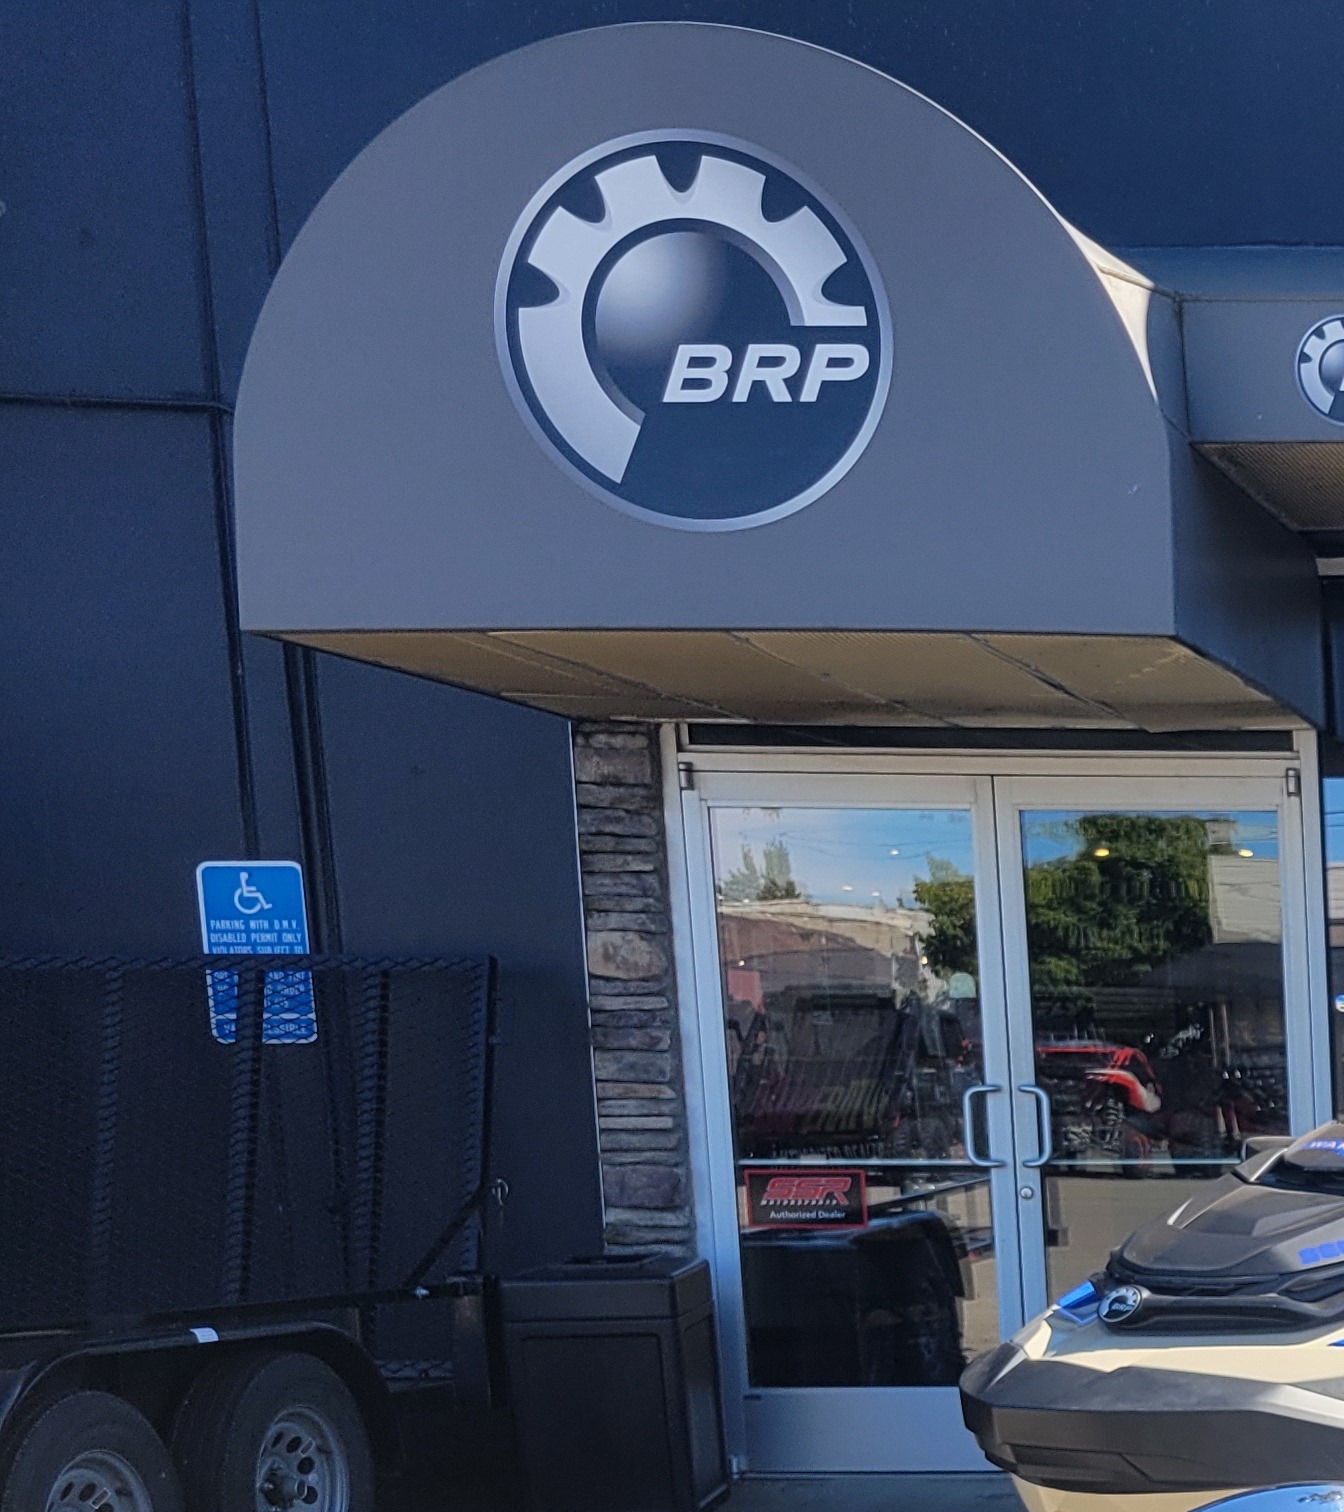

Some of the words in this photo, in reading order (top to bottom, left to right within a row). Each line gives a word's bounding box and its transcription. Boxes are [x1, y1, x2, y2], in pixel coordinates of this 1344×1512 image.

[662, 343, 870, 403] BRP
[210, 919, 245, 930] PARKING
[249, 919, 269, 930] WITH
[210, 932, 247, 943] DISABLED
[250, 932, 278, 943] PERMIT
[282, 932, 302, 943] ONLY
[763, 1177, 852, 1206] SSR
[769, 1210, 817, 1219] Authorized
[818, 1210, 846, 1219] Dealer
